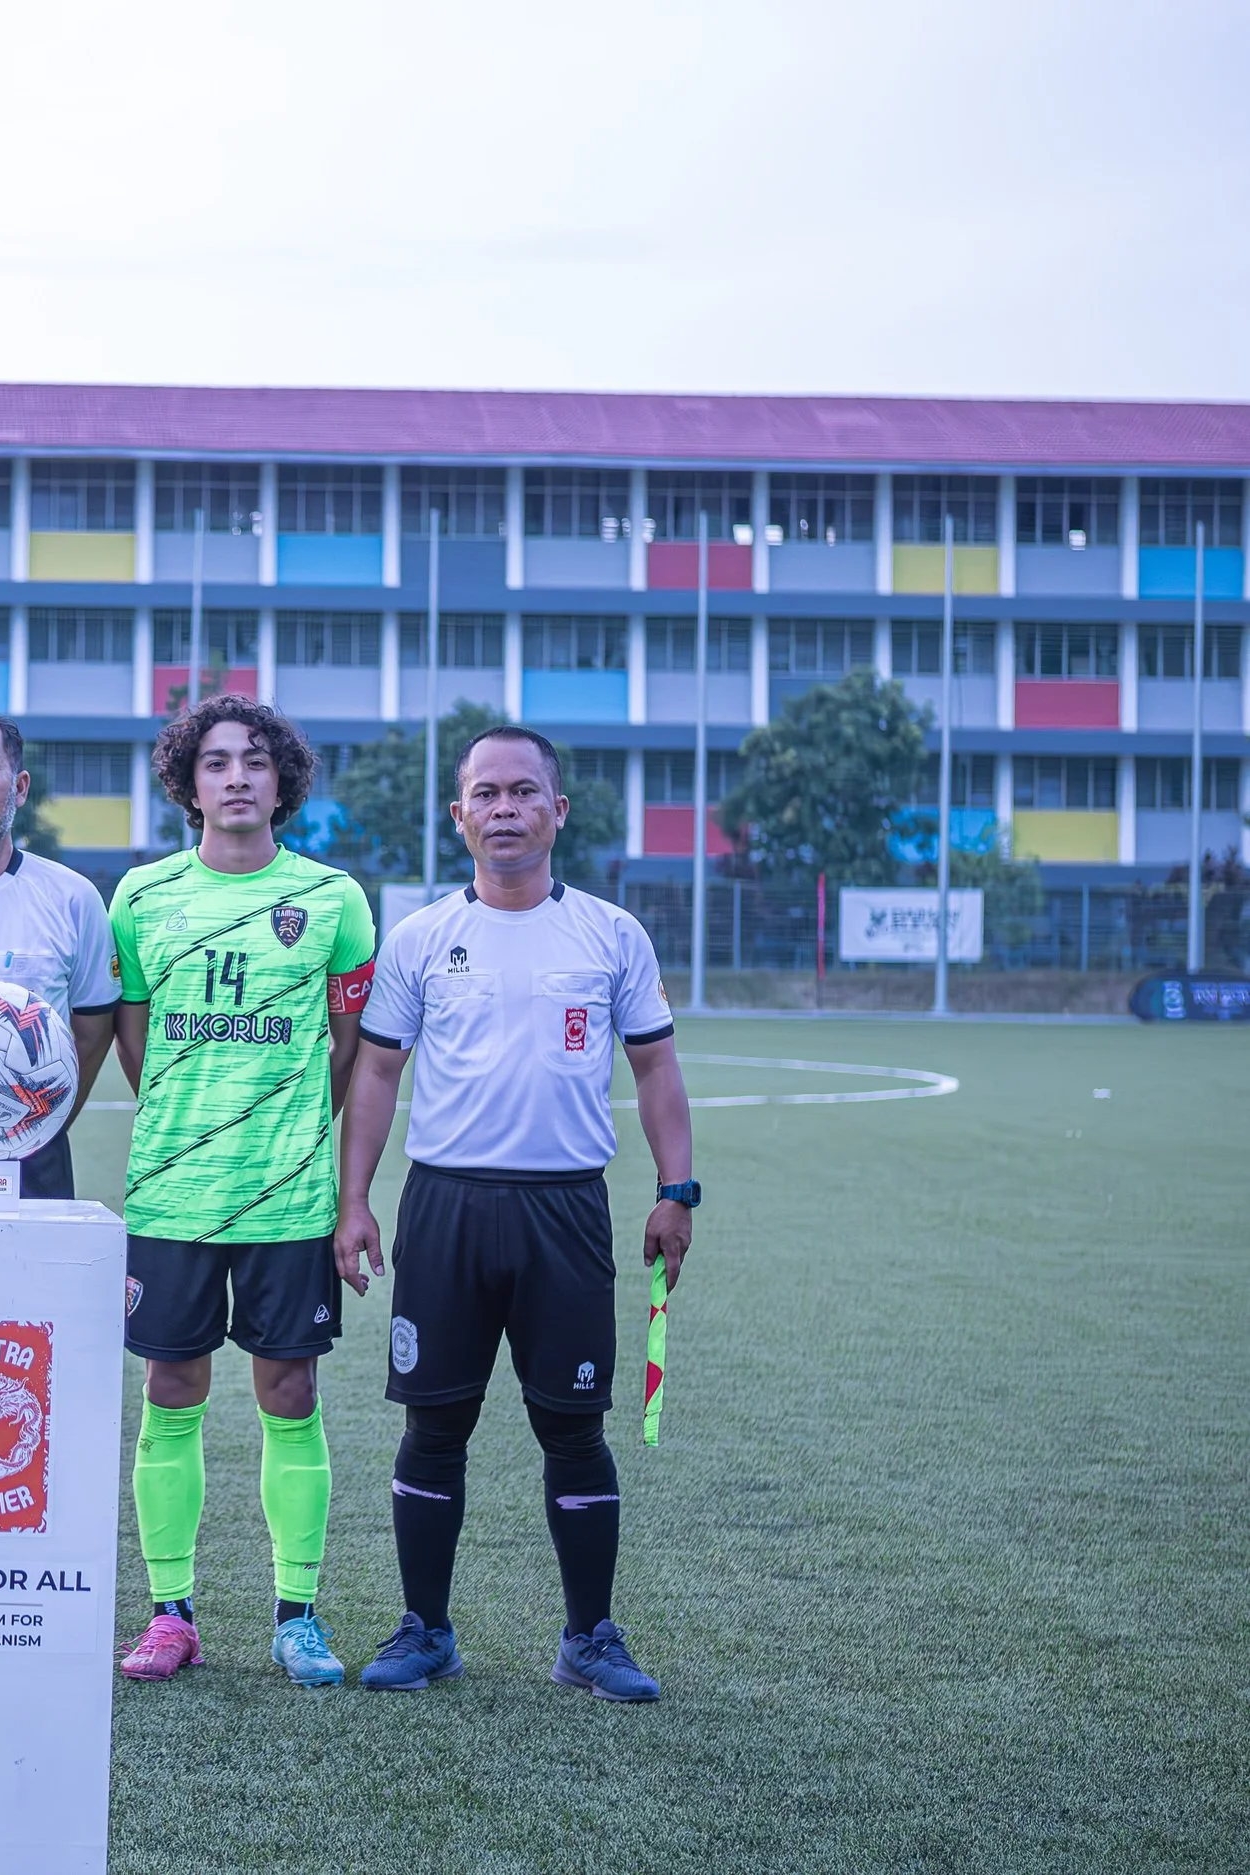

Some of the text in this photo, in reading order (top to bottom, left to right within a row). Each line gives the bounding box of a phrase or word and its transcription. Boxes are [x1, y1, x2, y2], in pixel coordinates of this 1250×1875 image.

[205, 949, 247, 1007] 14
[447, 966, 470, 974] MILLS
[190, 1013, 282, 1044] KORUS
[573, 1382, 595, 1390] MILLS
[36, 1570, 91, 1592] ALL
[11, 1614, 43, 1626] FOR
